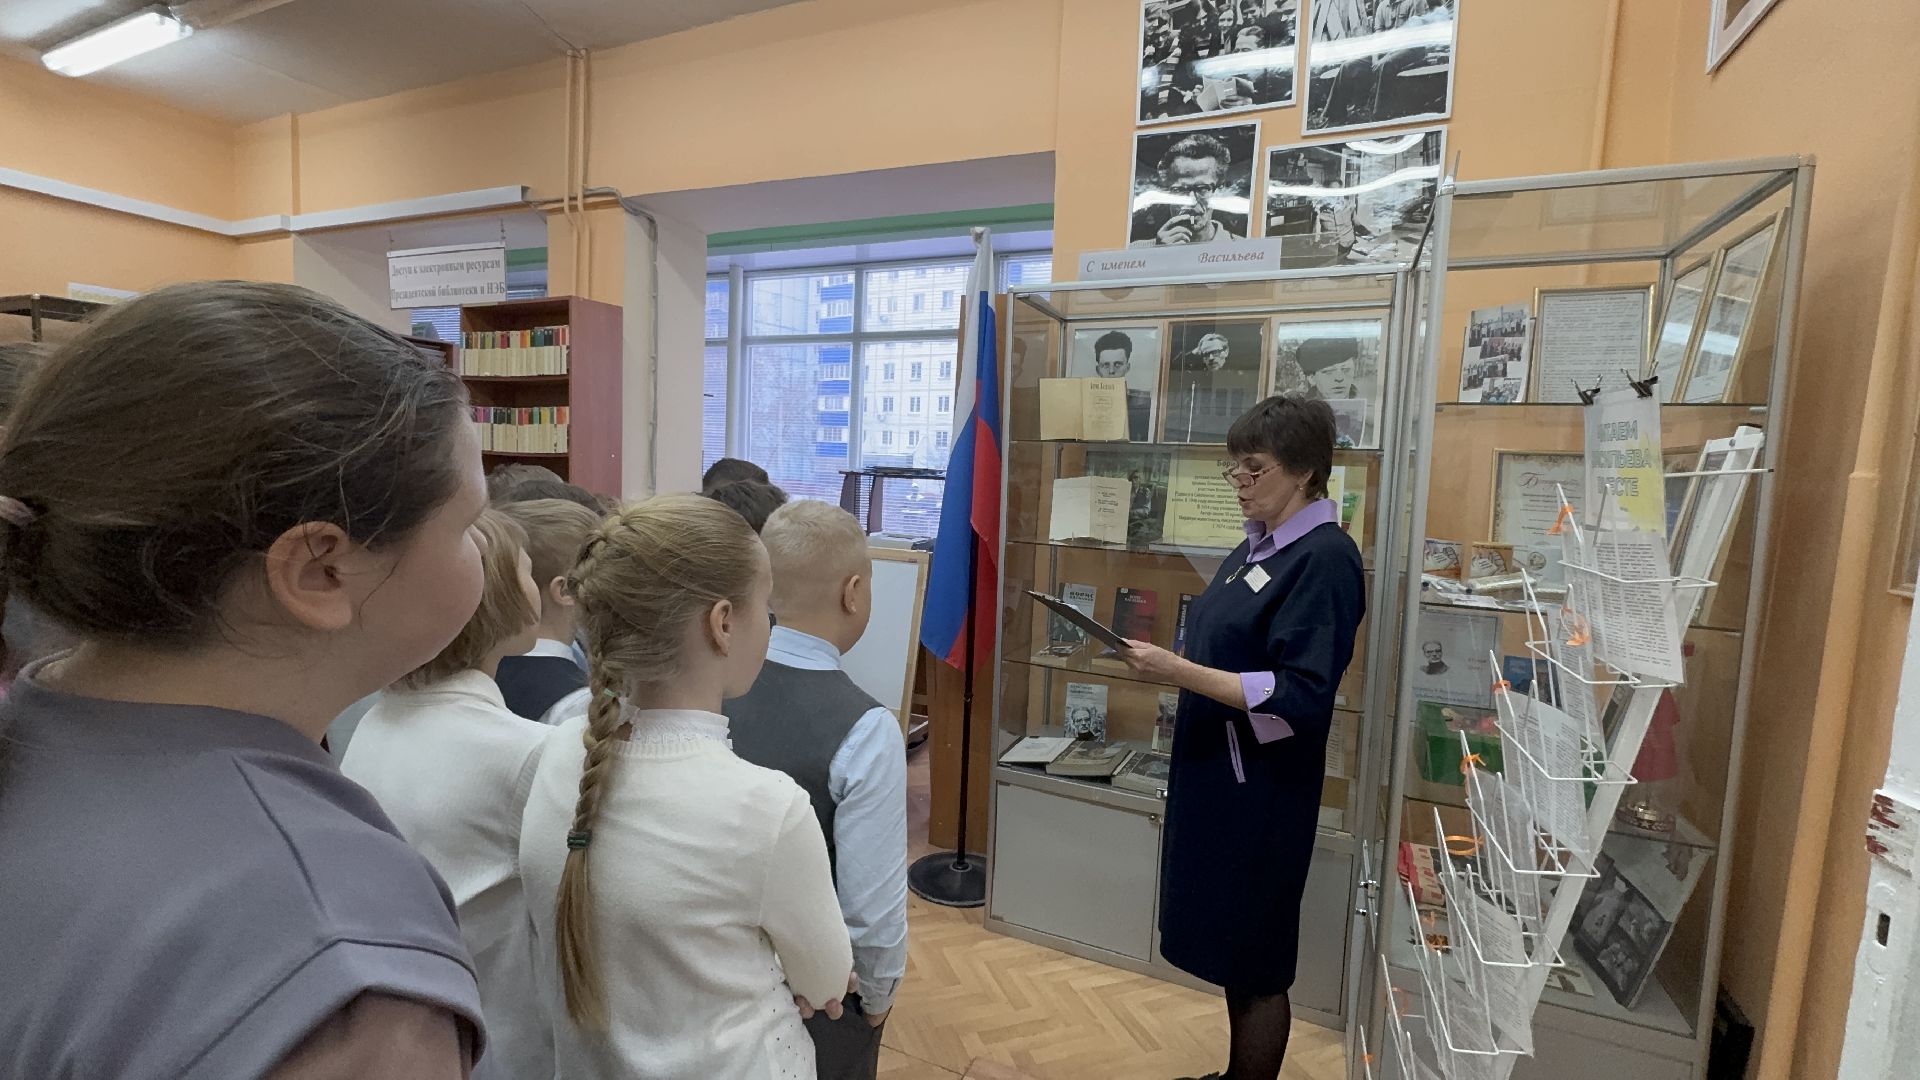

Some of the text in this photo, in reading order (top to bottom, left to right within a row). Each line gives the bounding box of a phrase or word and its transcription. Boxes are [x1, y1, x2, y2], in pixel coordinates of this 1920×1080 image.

[391, 264, 412, 277] Доступ
[466, 258, 501, 273] ресурсам
[1086, 250, 1265, 273] С именем Васильева
[437, 284, 478, 297] библиотеки
[487, 281, 505, 294] НЭБ
[1598, 420, 1639, 442] ТАЕМ
